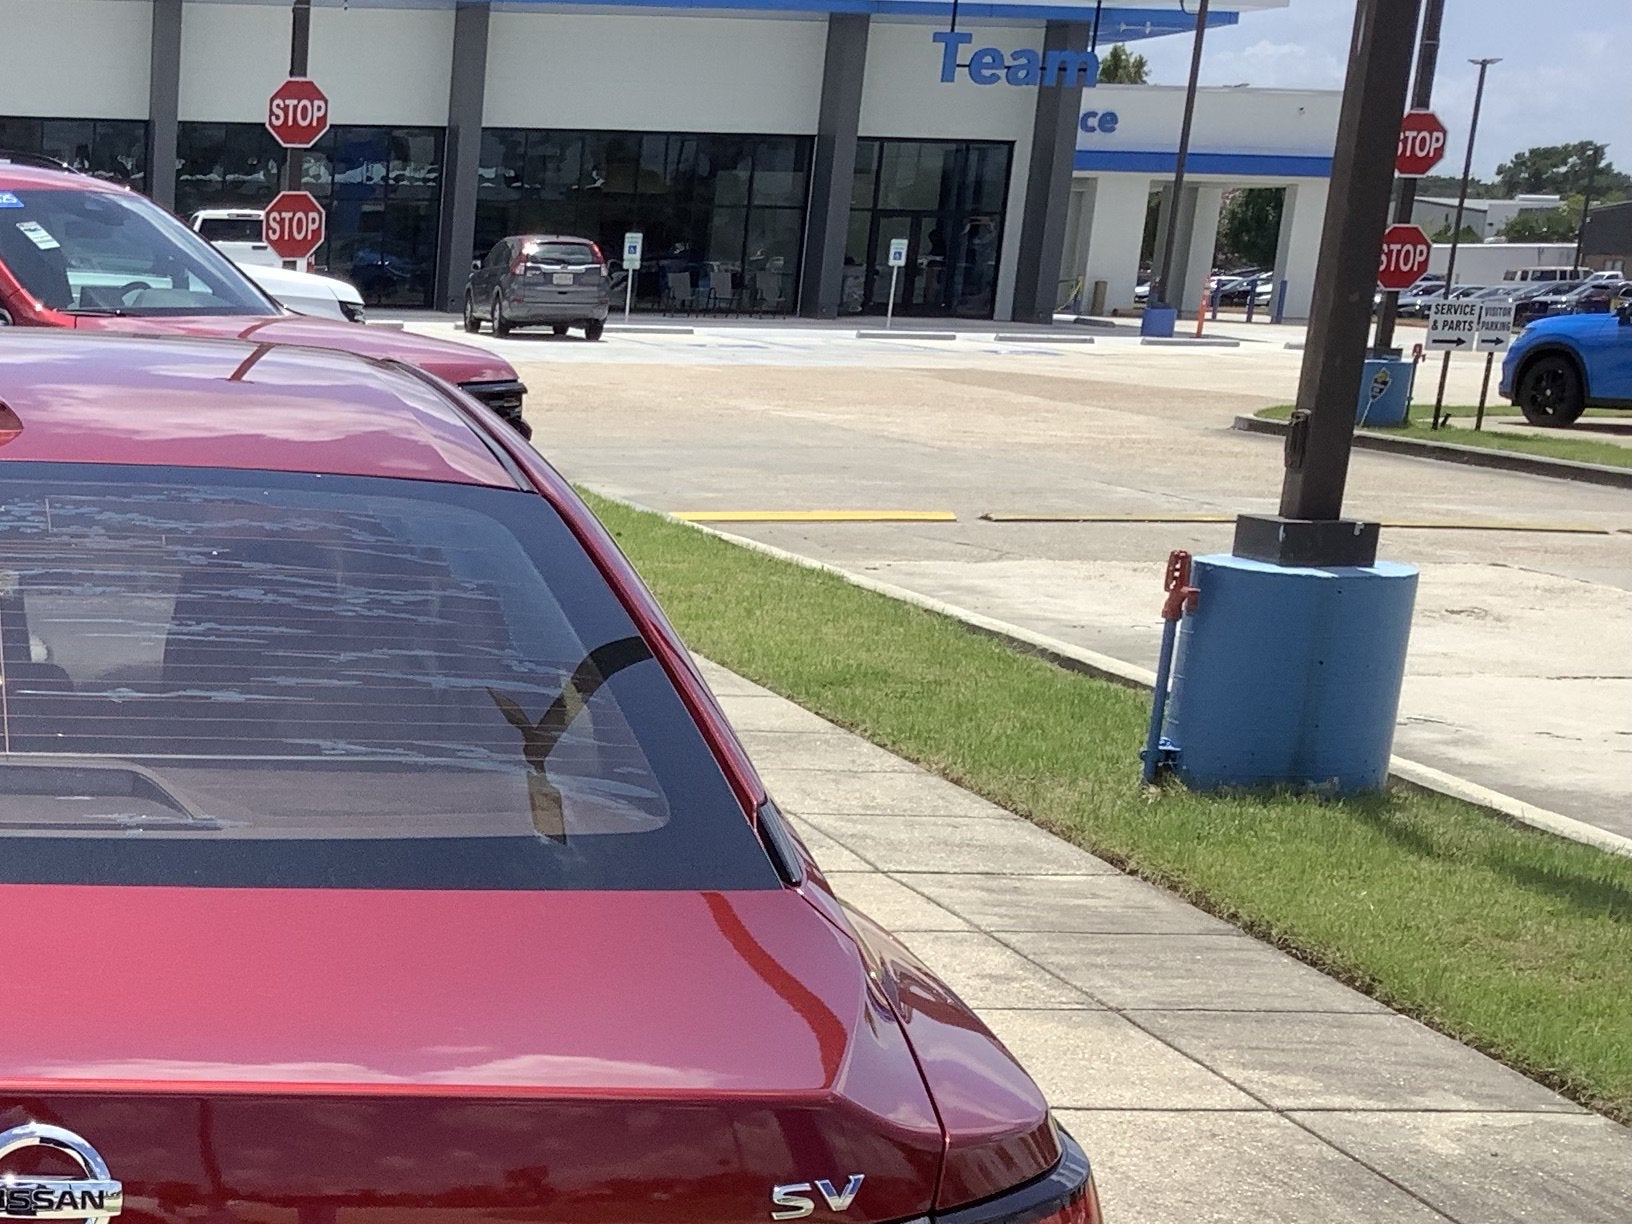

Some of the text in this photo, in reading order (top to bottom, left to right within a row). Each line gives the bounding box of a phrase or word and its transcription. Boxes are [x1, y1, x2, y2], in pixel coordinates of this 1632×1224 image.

[933, 32, 1099, 88] Team
[271, 98, 326, 127] STOP
[268, 211, 319, 240] STOP
[1434, 303, 1476, 316] SERVICE
[1431, 319, 1474, 332] & PARTS
[771, 1174, 866, 1220] SV
